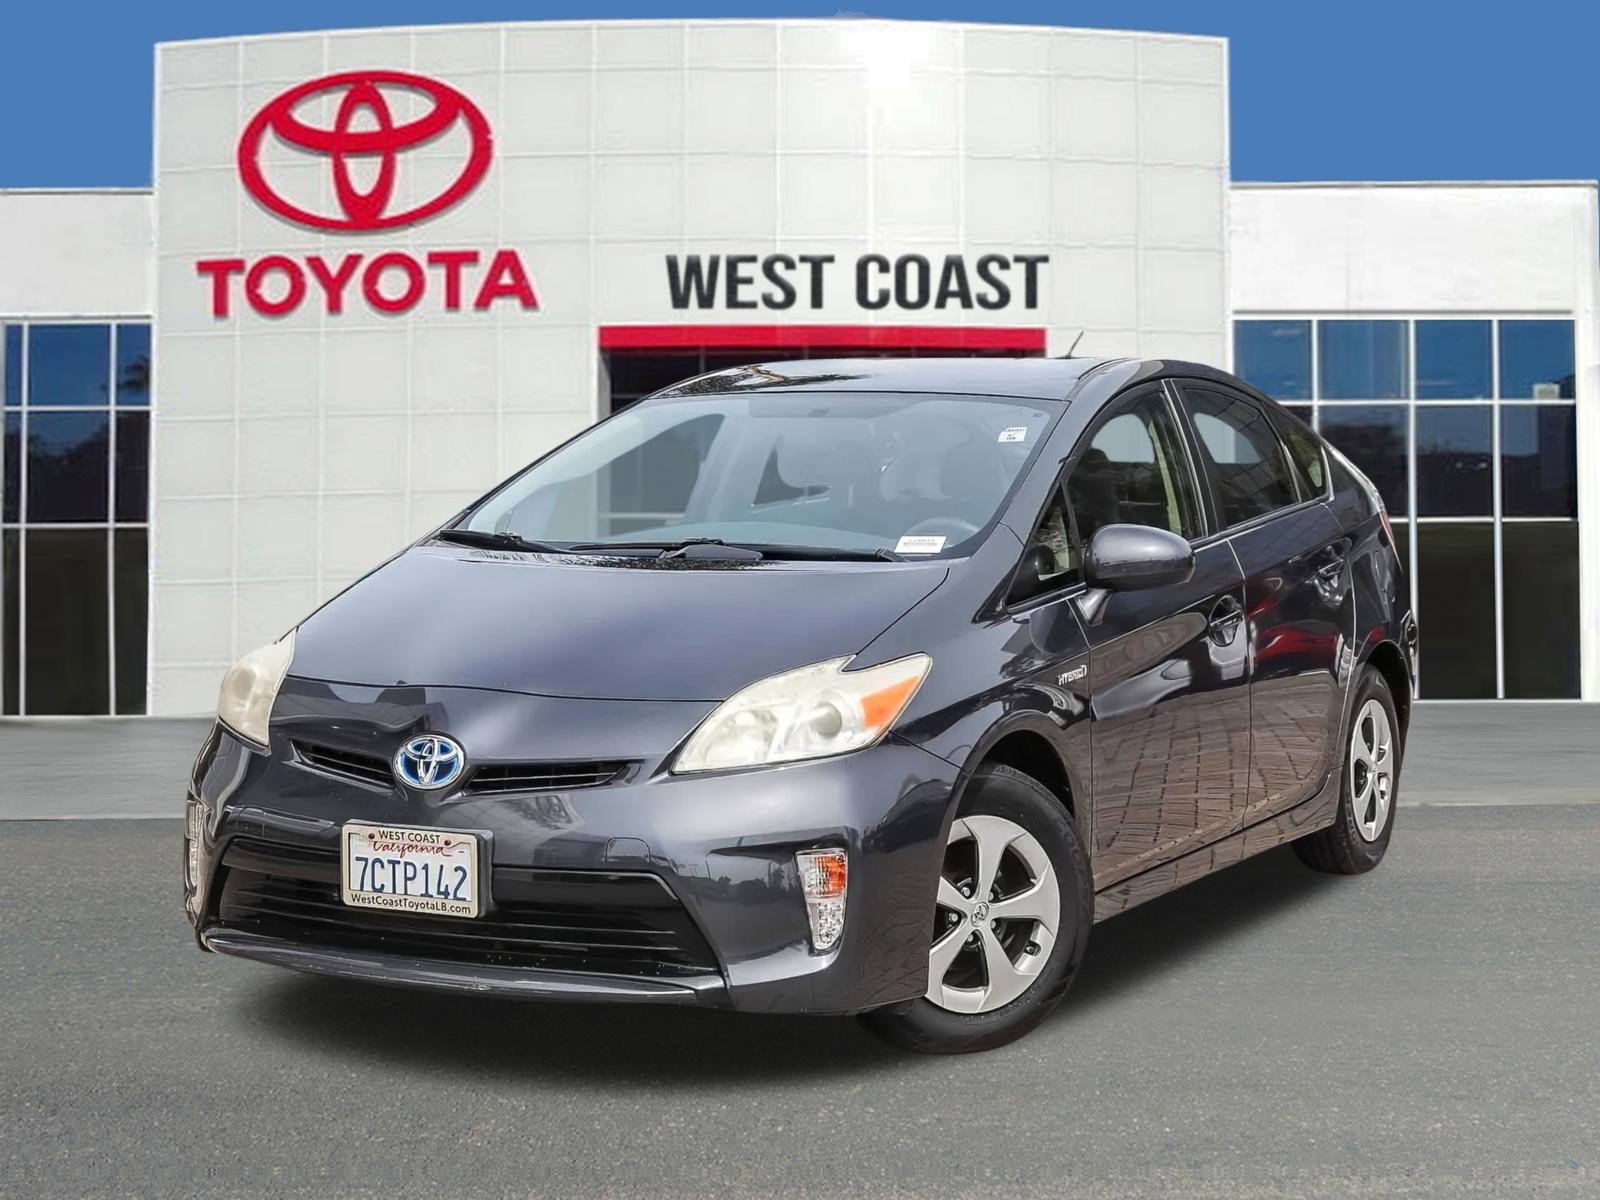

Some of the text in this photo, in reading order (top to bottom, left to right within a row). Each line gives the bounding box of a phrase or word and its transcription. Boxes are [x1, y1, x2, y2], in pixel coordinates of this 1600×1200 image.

[197, 249, 539, 318] TOYOTA
[665, 253, 1049, 311] WEST COAST
[373, 841, 453, 858] California
[378, 830, 441, 844] WEST COAST
[355, 856, 468, 902] 7CTP142
[351, 893, 471, 915] WestCoastToyotaLB.com
